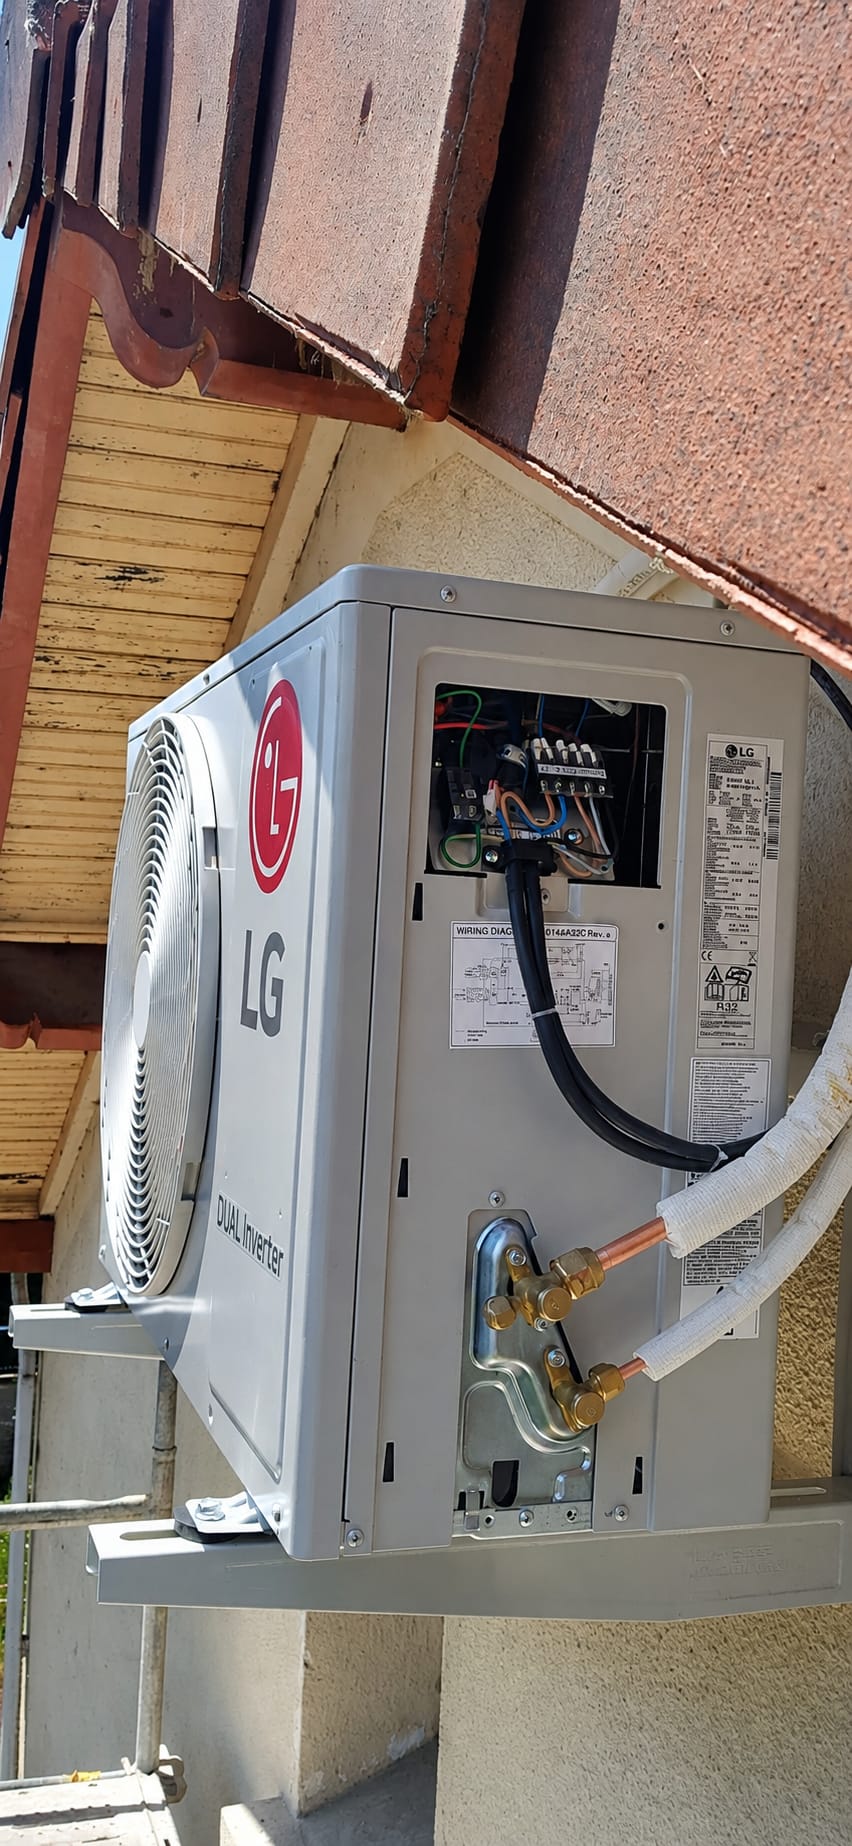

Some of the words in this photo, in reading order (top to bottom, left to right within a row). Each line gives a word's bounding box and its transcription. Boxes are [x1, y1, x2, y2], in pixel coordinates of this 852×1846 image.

[739, 746, 755, 758] LG
[456, 927, 489, 935] WIRING
[491, 927, 513, 936] DIAG
[701, 950, 713, 961] CE
[240, 929, 286, 1038] LG
[217, 1194, 241, 1244] DUAL
[242, 1213, 284, 1278] Inverter
